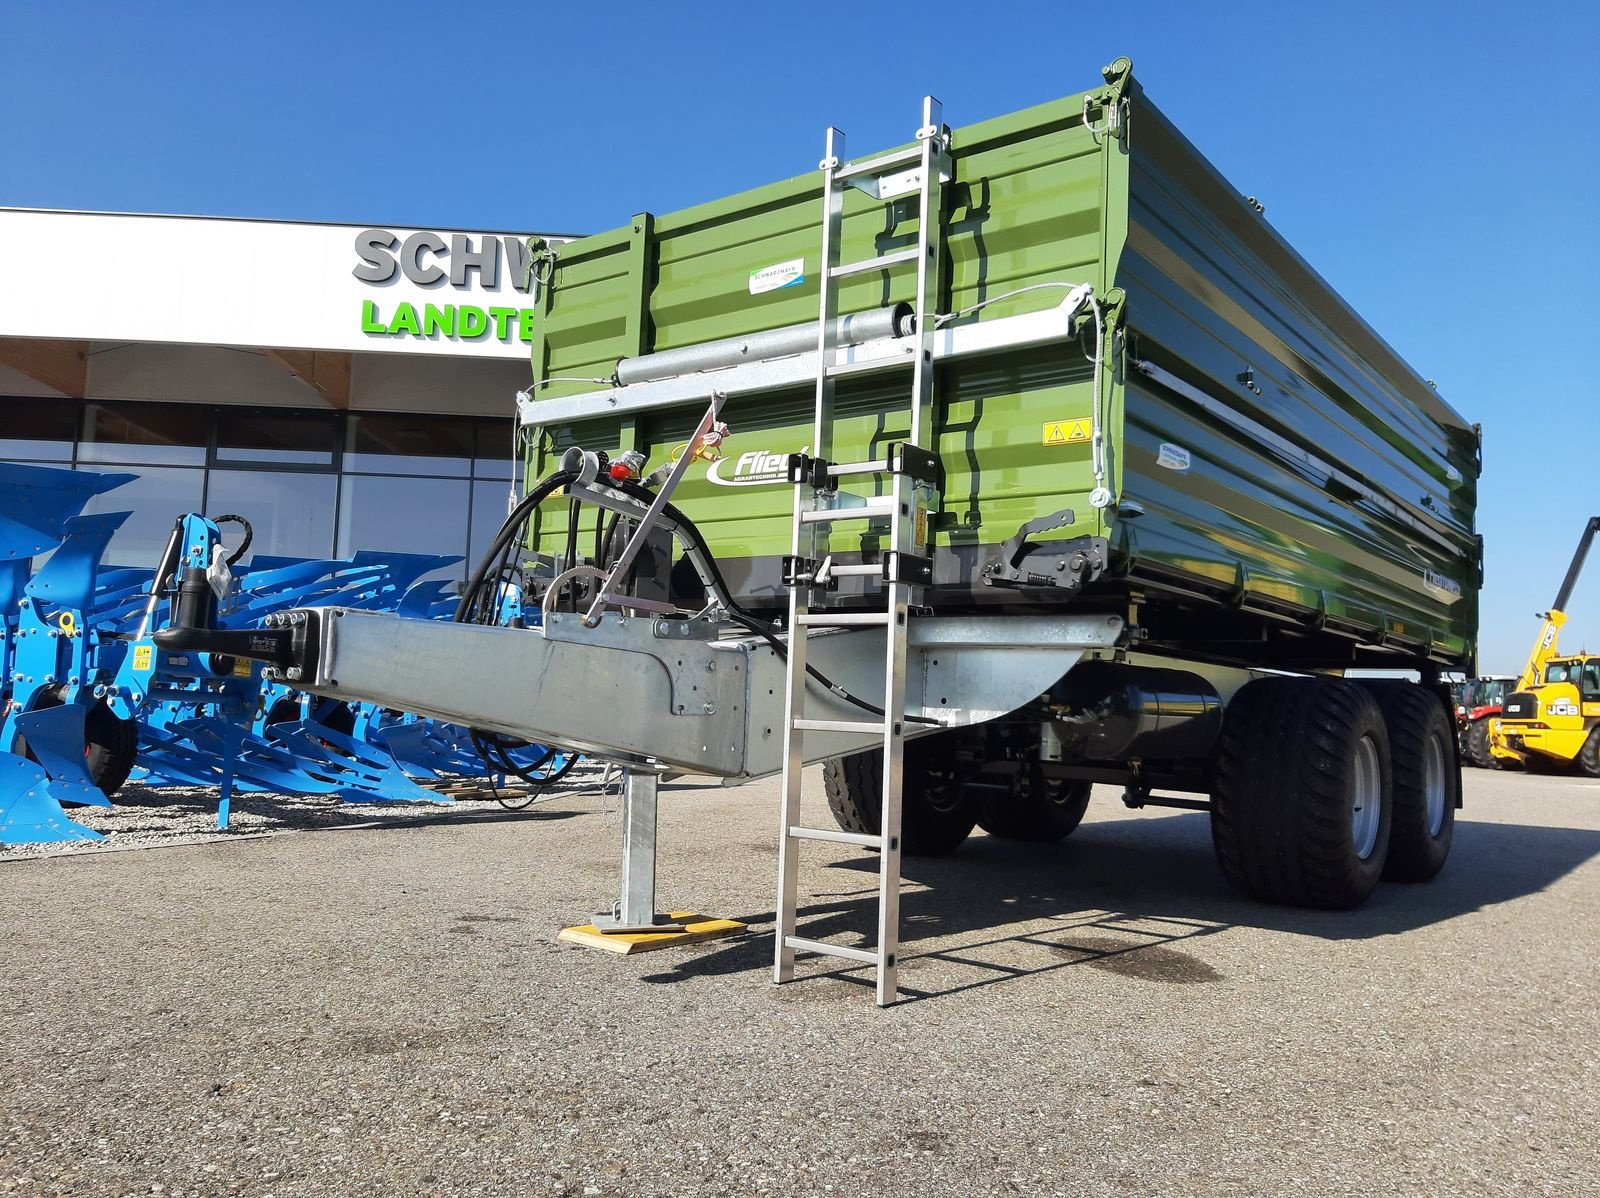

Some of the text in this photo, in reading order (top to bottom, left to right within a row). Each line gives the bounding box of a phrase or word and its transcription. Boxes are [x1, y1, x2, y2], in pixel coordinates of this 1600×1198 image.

[735, 446, 809, 475] Flie
[1543, 623, 1557, 650] JCB
[1508, 704, 1521, 713] JCB
[1547, 704, 1579, 716] JCB
